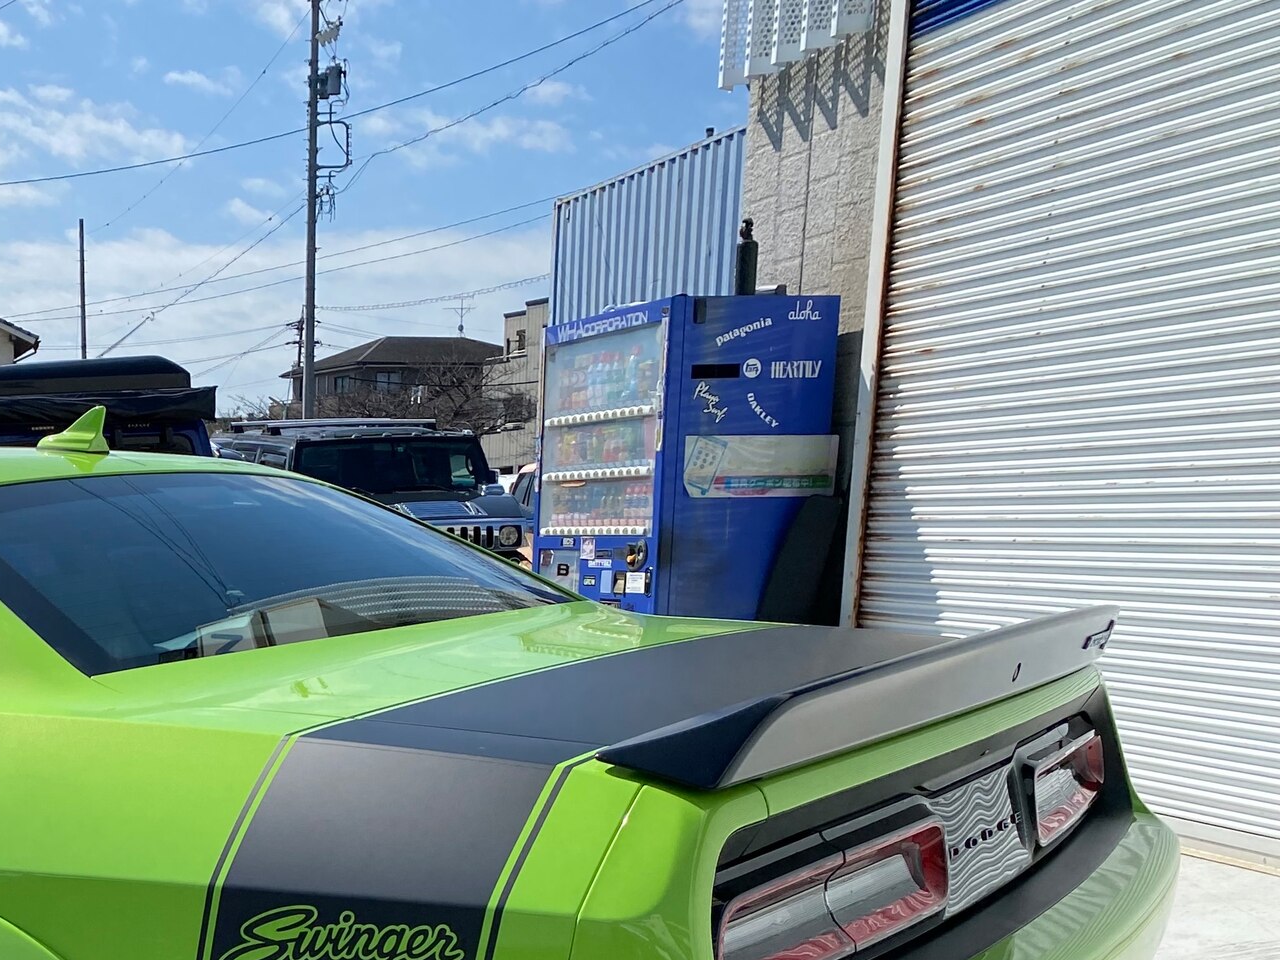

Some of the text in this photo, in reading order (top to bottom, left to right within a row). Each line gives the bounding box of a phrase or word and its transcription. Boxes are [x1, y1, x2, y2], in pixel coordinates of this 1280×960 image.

[788, 300, 822, 320] aloha
[715, 317, 773, 346] patagonia
[747, 392, 779, 428] OAKLEY
[950, 811, 1023, 860] DODGE
